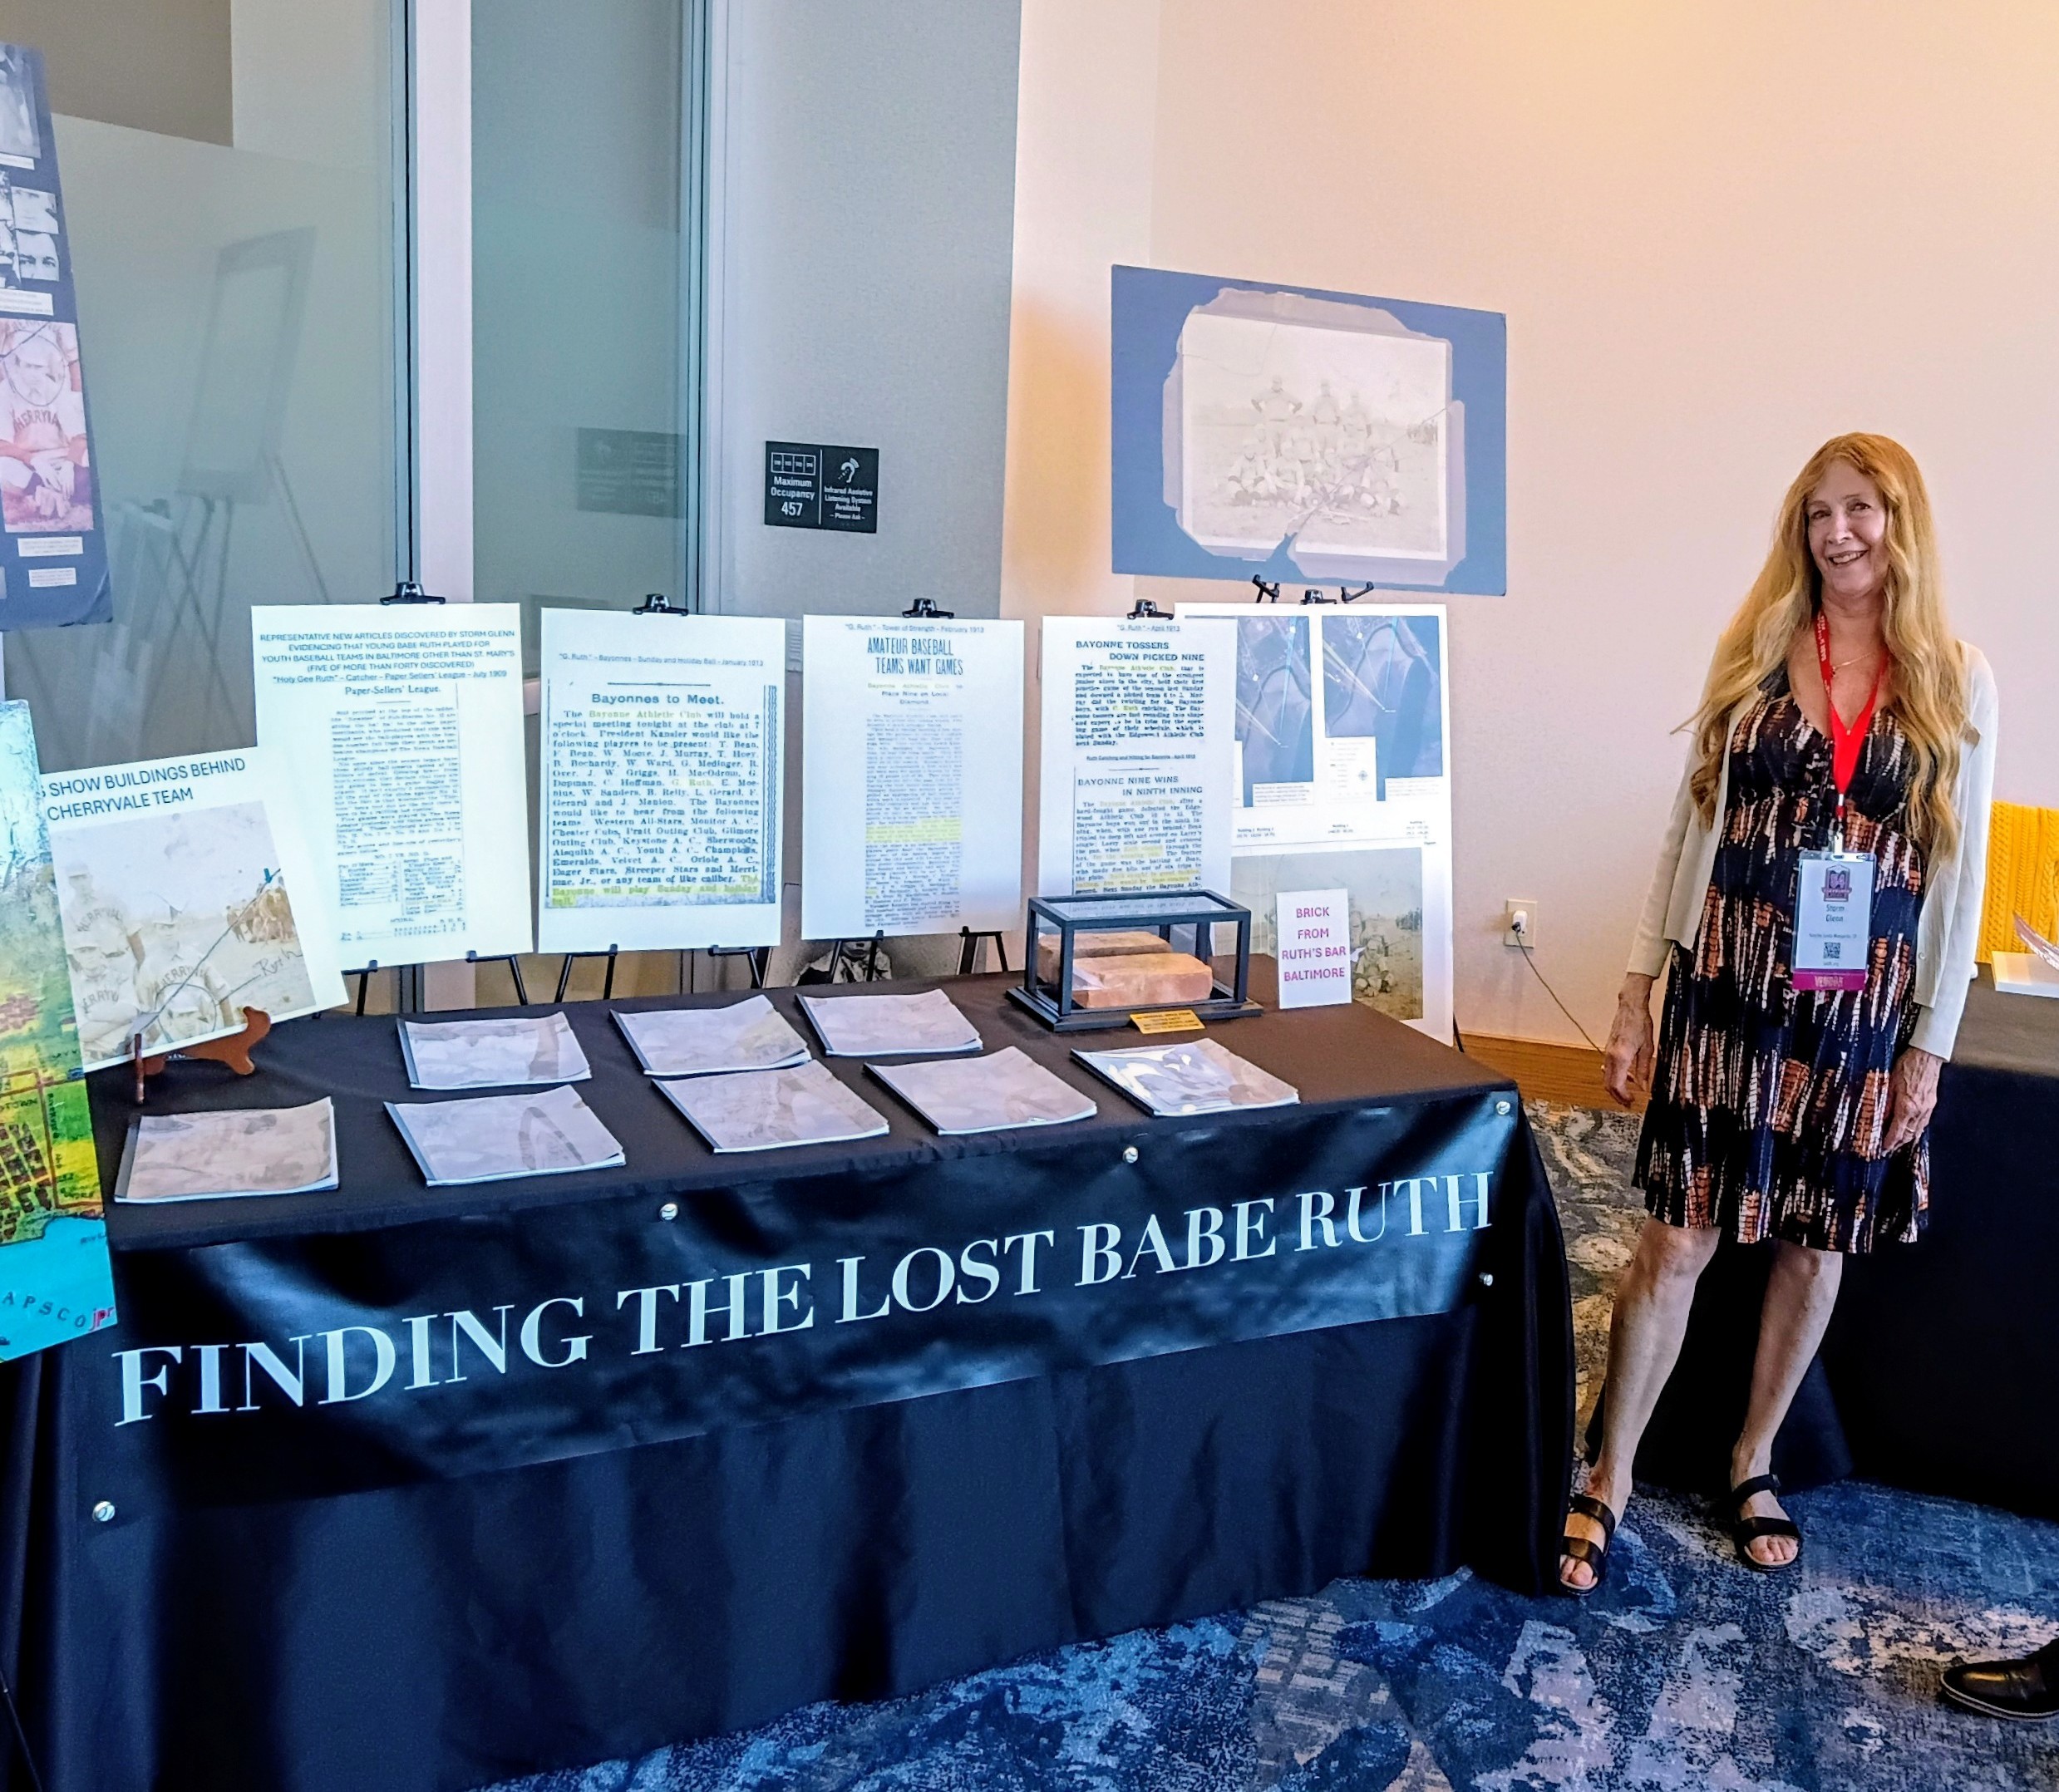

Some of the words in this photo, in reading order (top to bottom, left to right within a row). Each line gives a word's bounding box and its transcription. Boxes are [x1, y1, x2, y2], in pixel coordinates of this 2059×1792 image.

[774, 476, 811, 488] Maximum
[771, 487, 815, 500] Occupancy
[781, 502, 803, 516] 457
[868, 638, 908, 654] AMATEUR
[912, 639, 953, 656] BASEBALL
[421, 661, 475, 669] DISCOVERED)
[876, 657, 904, 674] TEAMS
[909, 658, 930, 674] WANT
[936, 659, 963, 675] GAMES
[273, 676, 294, 684] "Holy
[439, 671, 465, 679] League
[345, 686, 405, 696] Paper-Sellers'
[408, 684, 441, 695] League.
[592, 694, 659, 705] Bayonnes
[667, 695, 680, 703] to
[687, 695, 724, 705] Meet.
[564, 710, 582, 718] The
[553, 721, 586, 729] special
[638, 721, 672, 729] tonight
[553, 740, 598, 748] following
[48, 776, 101, 797] SHOW
[106, 765, 188, 789] BUILDINGS
[190, 757, 245, 779] BEHIND
[47, 794, 150, 821] CHERRYVALE
[152, 786, 194, 807] TEAM
[1296, 907, 1329, 918] BRICK
[1298, 928, 1329, 939] FROM
[1282, 948, 1323, 960] RUTH'S
[1325, 946, 1346, 958] BAR
[1284, 967, 1345, 982] BALTIMORE
[111, 1296, 594, 1426] FINDING
[618, 1263, 815, 1356] THE
[834, 1230, 1055, 1325] LOST
[1075, 1198, 1277, 1287] BABE
[1293, 1171, 1494, 1253] RUTH
